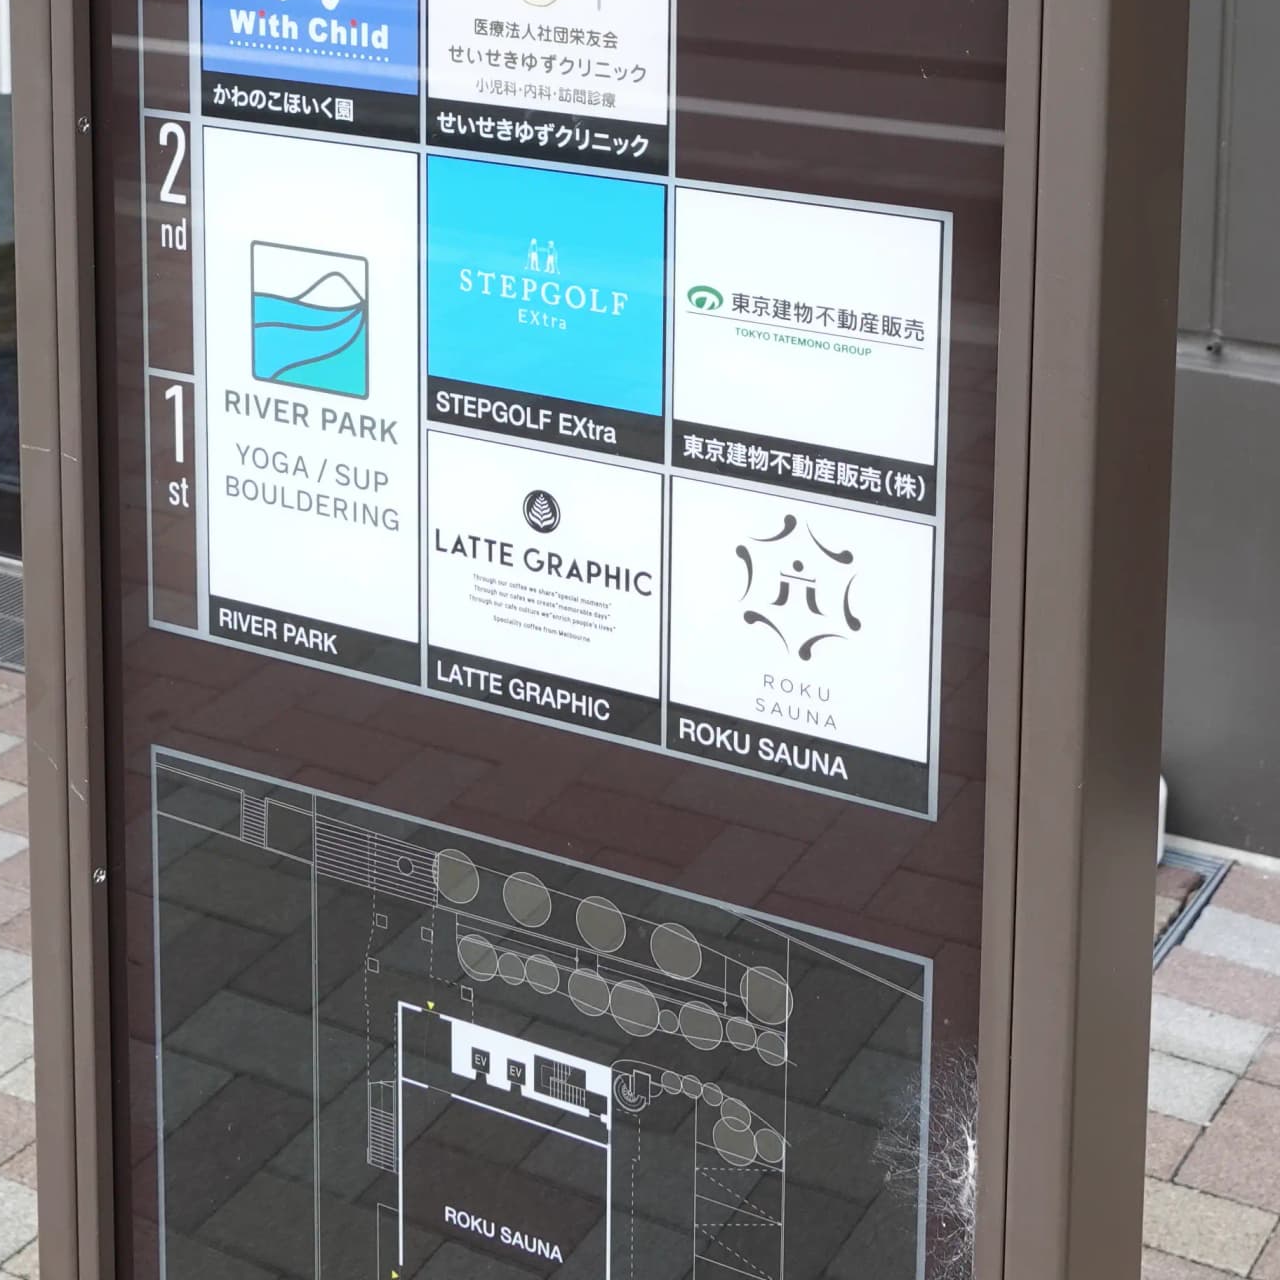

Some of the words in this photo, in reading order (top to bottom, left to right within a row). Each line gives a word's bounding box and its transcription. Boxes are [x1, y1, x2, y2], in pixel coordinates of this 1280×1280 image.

[230, 8, 298, 40] With
[308, 17, 389, 50] Child
[474, 18, 618, 49] 医療法人社団栄友会
[448, 45, 647, 84] せいせきゆずクリニック
[213, 83, 354, 122] かわのこほいく園
[437, 111, 649, 158] せいせきゆずクリニック
[159, 122, 187, 205] 2
[161, 218, 187, 251] nd
[459, 268, 629, 316] STEPGOLF
[518, 308, 567, 330] EXtra
[731, 292, 926, 343] 東京建物不動産販売
[735, 326, 770, 341] TOKYO
[773, 333, 831, 351] TATEMONO
[833, 342, 872, 357] GROUP
[165, 384, 184, 463] 1
[225, 389, 309, 428] RIVER
[321, 407, 398, 445] PARK
[435, 390, 552, 430] STEPGOLF
[558, 413, 617, 444] EXtra
[236, 443, 309, 479] YOGA
[317, 459, 328, 483] /
[335, 463, 389, 493] SUP
[683, 434, 926, 501] 東京建物不動産販売(株)
[169, 477, 189, 508] st
[226, 475, 400, 532] BOULDERING
[435, 528, 514, 568] LATTE
[523, 547, 653, 597] GRAPHIC
[219, 608, 277, 640] RIVER
[283, 624, 338, 654] PARK
[437, 660, 502, 695] LATTE
[509, 678, 610, 721] GRAPHIC
[763, 674, 830, 703] ROKU
[755, 698, 837, 730] SAUNA
[679, 717, 750, 755] ROKU
[758, 737, 848, 780] SAUNA
[474, 1055, 487, 1067] EV
[510, 1066, 522, 1078] EV
[445, 1206, 495, 1238] ROKU
[500, 1227, 564, 1264] SAUNA
